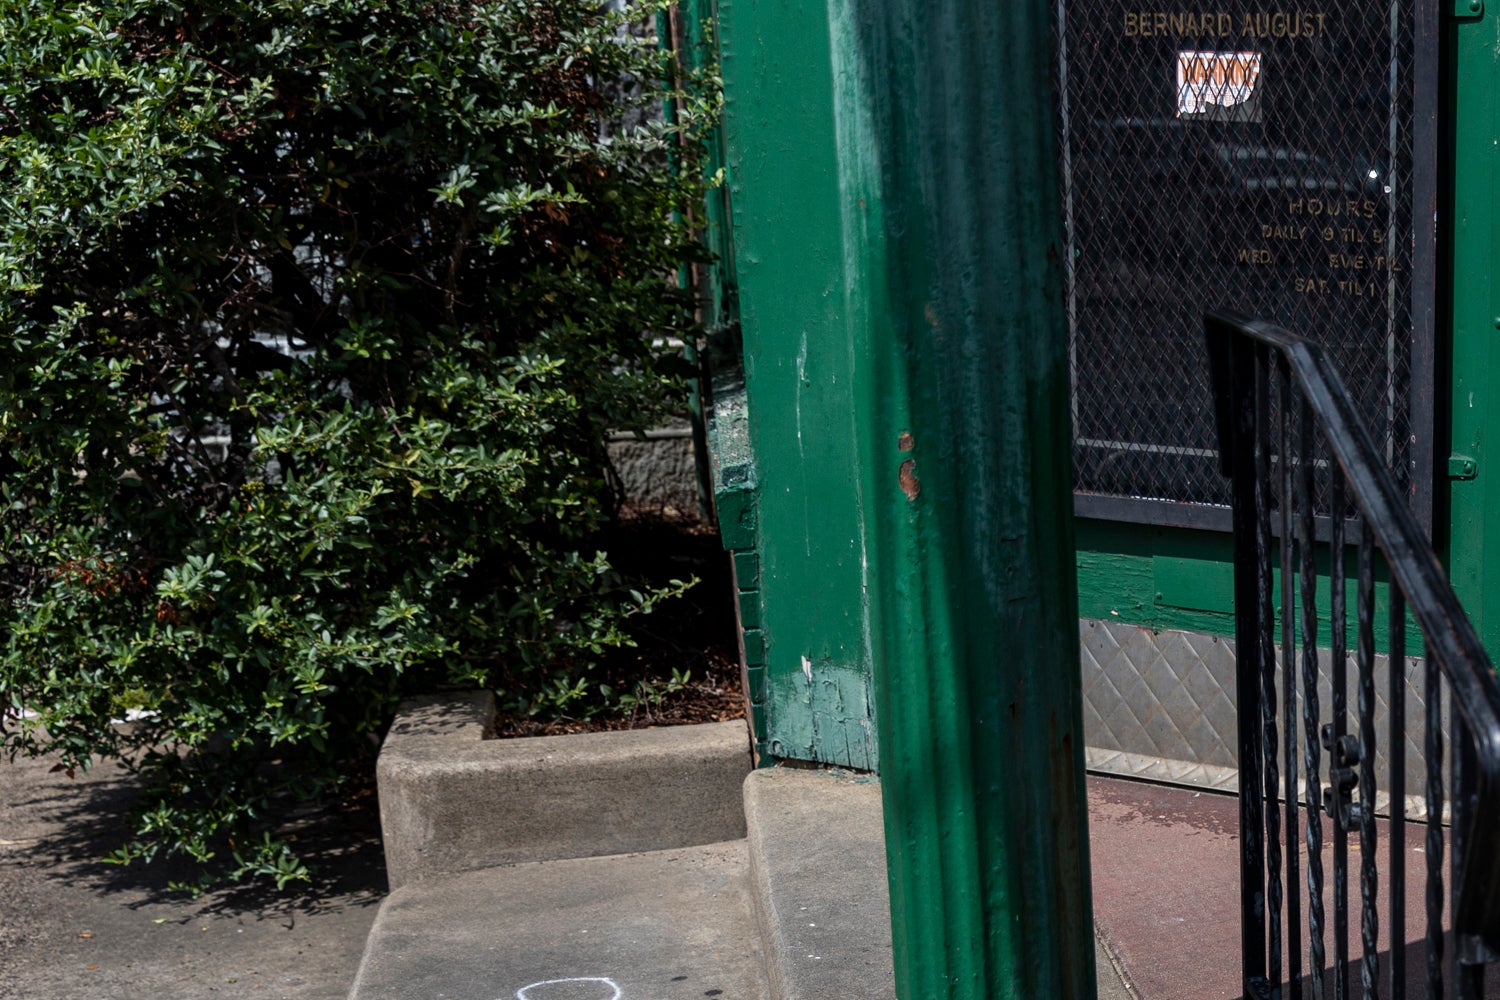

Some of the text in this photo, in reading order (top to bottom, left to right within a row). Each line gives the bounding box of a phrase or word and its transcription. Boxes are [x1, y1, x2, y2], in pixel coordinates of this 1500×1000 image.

[1124, 12, 1325, 38] BERNARD AUGUST
[1180, 57, 1259, 86] WARNING
[1289, 198, 1375, 219] HOURS
[1262, 224, 1306, 241] DAILY
[1343, 229, 1364, 243] TIL
[1339, 280, 1362, 296] TIL
